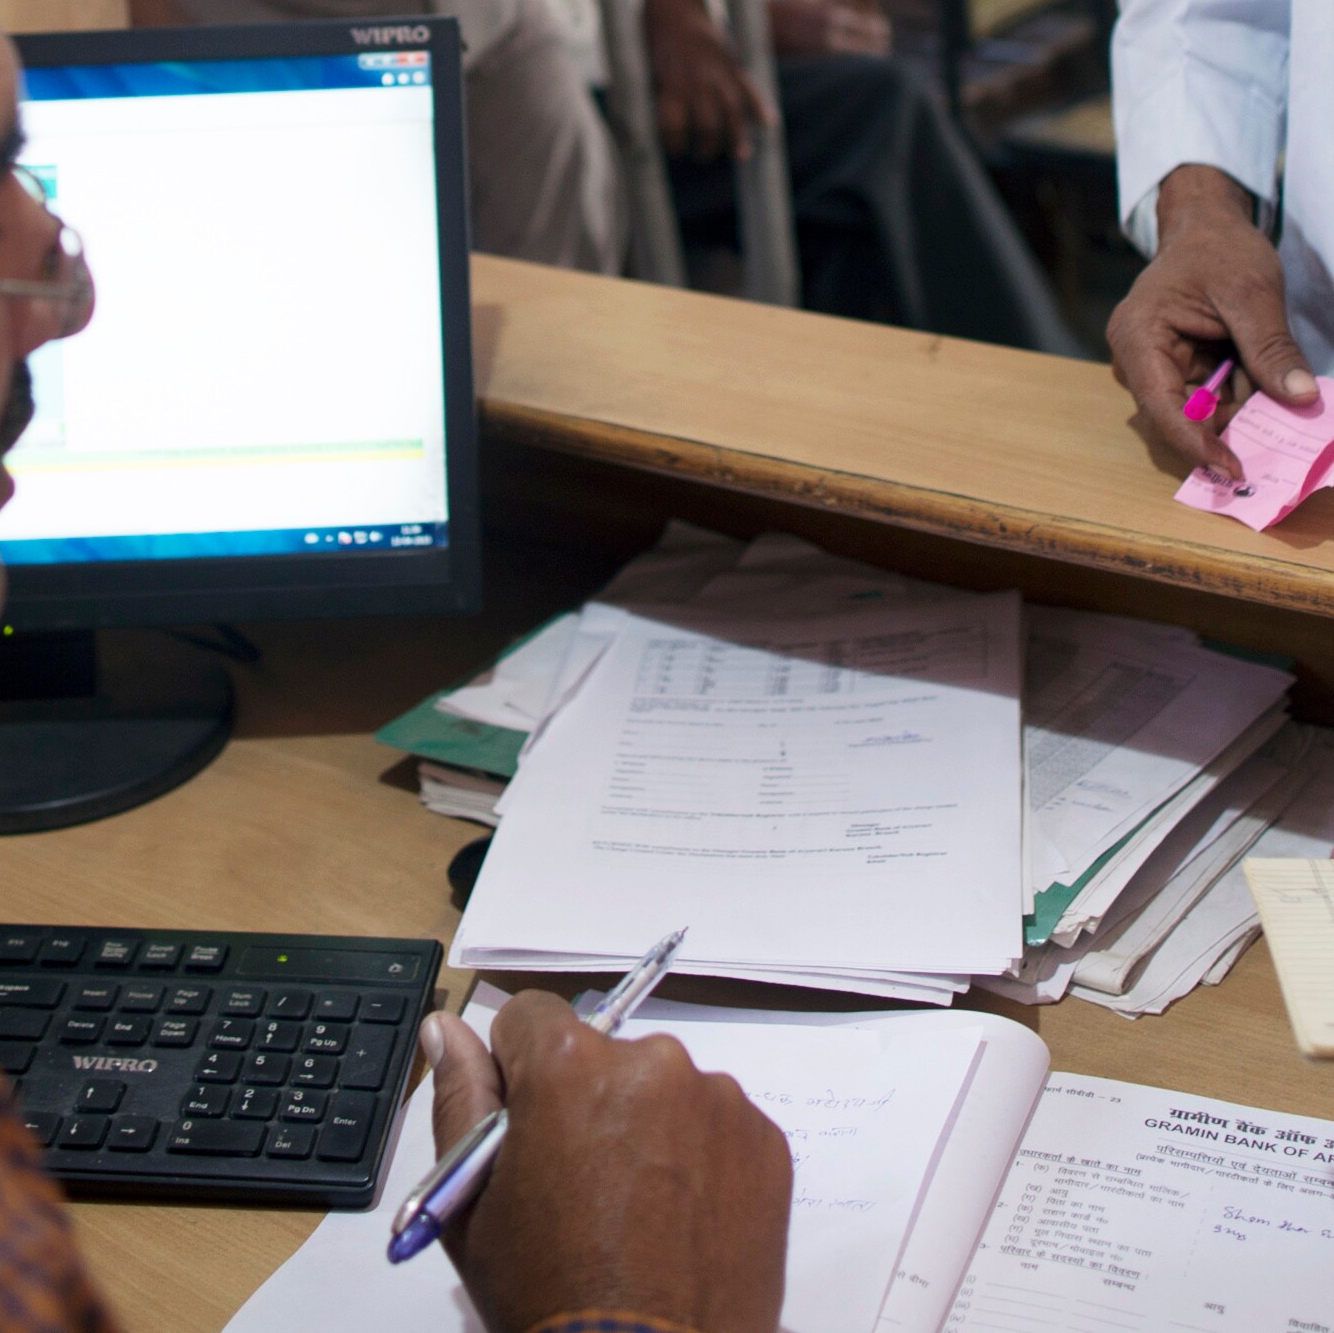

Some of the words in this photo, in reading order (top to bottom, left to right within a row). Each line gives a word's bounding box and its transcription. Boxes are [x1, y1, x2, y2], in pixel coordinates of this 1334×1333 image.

[349, 25, 430, 45] WIPRO
[68, 1020, 96, 1029] Delete
[115, 1023, 133, 1031] End
[315, 1025, 327, 1035] 9
[214, 1034, 243, 1043] Home
[310, 1038, 323, 1047] Pg
[324, 1039, 338, 1047] Up
[72, 1054, 159, 1073] WIPRO
[255, 1055, 266, 1065] 5
[1109, 1096, 1122, 1104] 23
[189, 1101, 209, 1110] End
[288, 1104, 301, 1114] Pg
[302, 1106, 316, 1114] Dn
[182, 1121, 193, 1130] 0
[332, 1116, 358, 1126] Enter
[1169, 1107, 1228, 1129] ग्रामीण
[1235, 1118, 1268, 1138] बैंक
[1274, 1128, 1318, 1146] ऑफ
[175, 1136, 190, 1144] Ins
[275, 1140, 292, 1148] Del
[1144, 1118, 1219, 1142] GRAMIN
[1224, 1133, 1278, 1154] BANK
[1283, 1144, 1310, 1160] OF
[1106, 1162, 1119, 1173] का
[1124, 1166, 1142, 1177] नाम
[1230, 1158, 1248, 1172] एवं
[1033, 1162, 1050, 1174] (क)
[1057, 1166, 1087, 1179] विवरण
[1000, 1243, 1032, 1258] परिवार
[1108, 1263, 1141, 1278] विवरण
